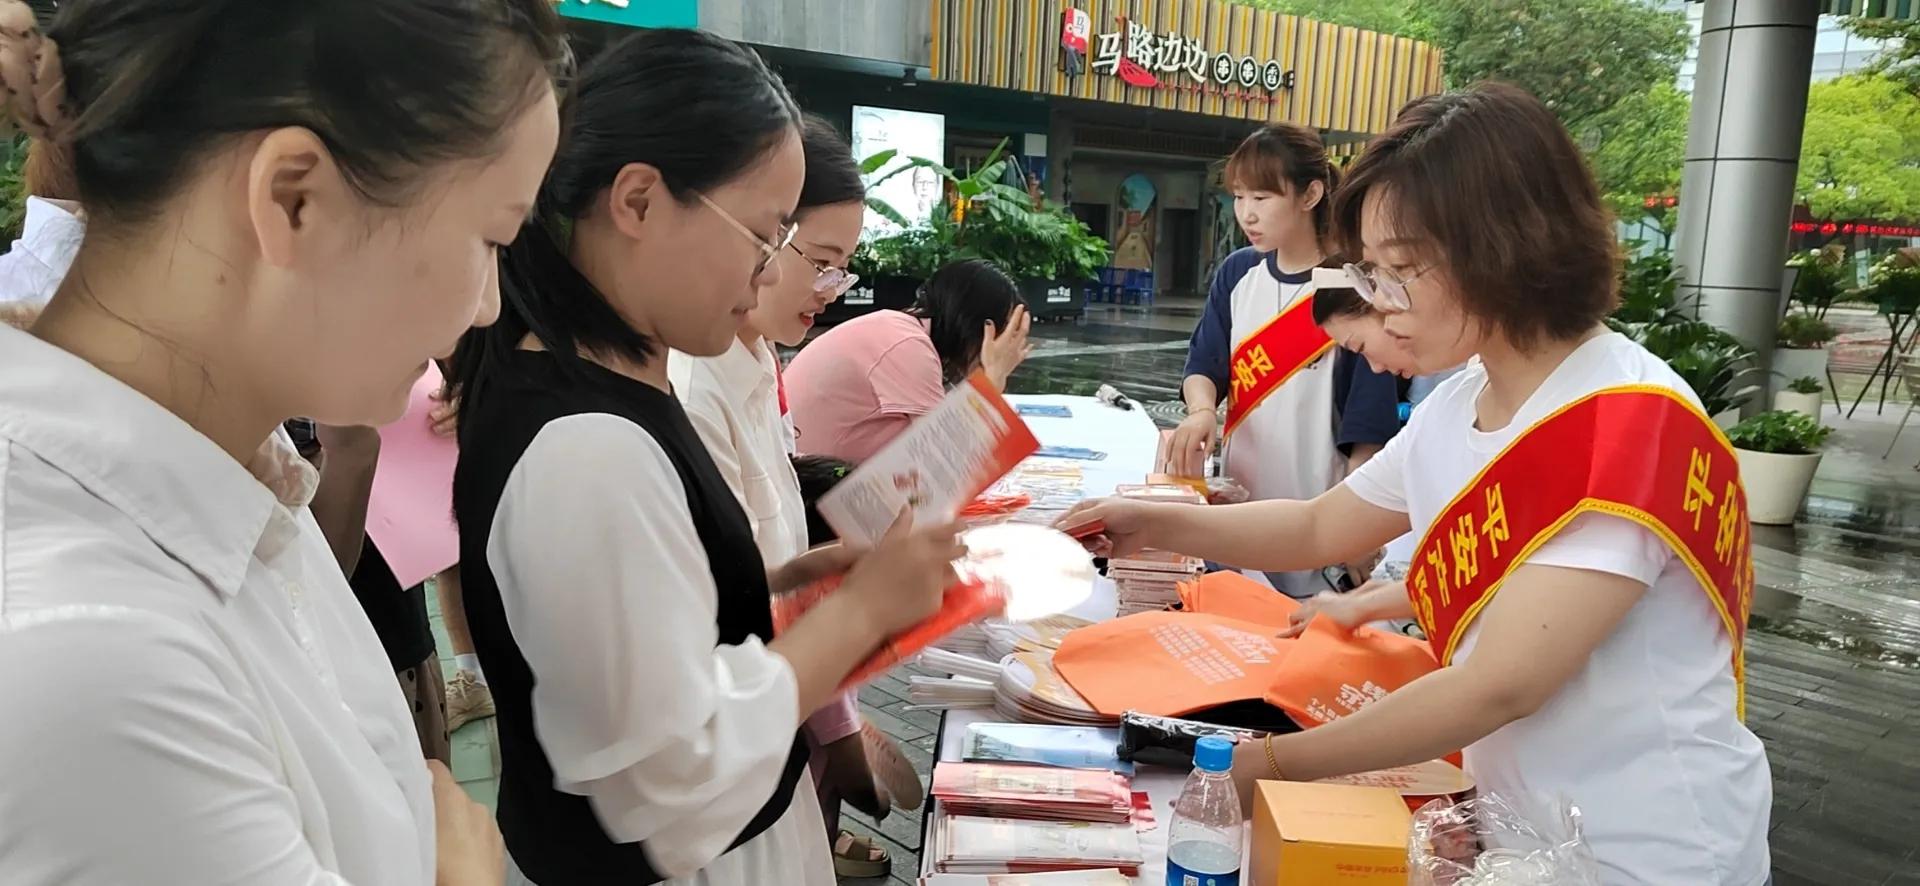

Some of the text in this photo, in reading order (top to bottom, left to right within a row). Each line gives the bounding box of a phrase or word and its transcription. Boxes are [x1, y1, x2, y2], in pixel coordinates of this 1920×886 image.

[1091, 20, 1208, 83] 马路边边
[1215, 55, 1280, 88] 串串香
